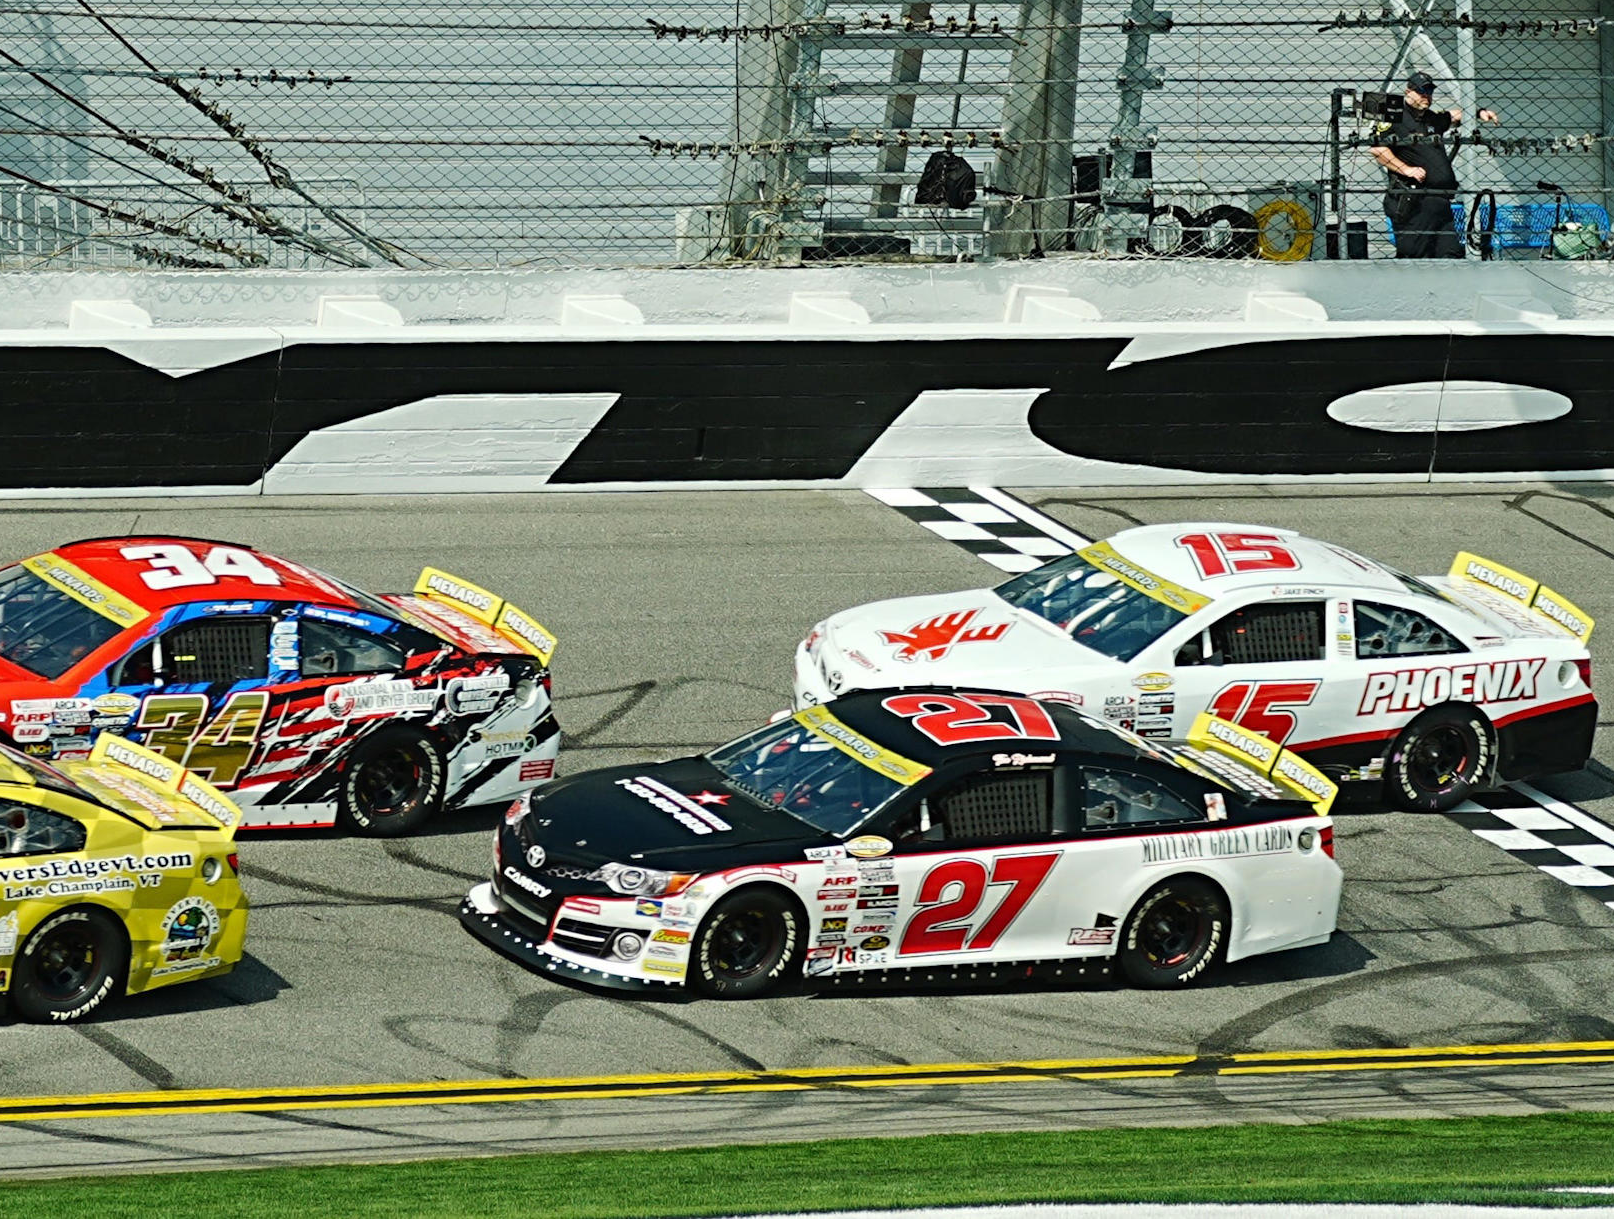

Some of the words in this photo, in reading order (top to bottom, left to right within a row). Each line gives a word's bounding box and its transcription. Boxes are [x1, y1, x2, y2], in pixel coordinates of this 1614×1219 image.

[119, 543, 284, 591] 34
[1103, 556, 1159, 591] MENARDS
[1174, 532, 1303, 581] 15
[46, 566, 106, 605] MENARDS
[427, 574, 493, 612] MENARDS
[1466, 561, 1529, 600] MENARDS
[504, 610, 553, 653] MENARDS
[1535, 593, 1587, 636] MENARDS
[54, 700, 77, 710] ARCA
[1103, 695, 1126, 706] ARCA
[1357, 657, 1547, 716] PHOENIX
[15, 713, 52, 723] ARP
[881, 692, 1062, 747] 27
[1205, 678, 1324, 750] 15
[137, 692, 271, 787] 34
[817, 720, 881, 760] MENARDS
[1206, 720, 1272, 762] MENARDS
[105, 741, 174, 783] MENARDS
[1276, 757, 1333, 800] MENARDS
[180, 778, 236, 828] MENARDS
[809, 849, 832, 860] ARCA
[1139, 835, 1204, 864] MILITARY
[1209, 832, 1250, 857] GREEN
[1255, 825, 1294, 853] CARDS
[4, 886, 44, 901] Lake
[48, 877, 136, 896] Champlain,
[139, 873, 163, 887] VT
[504, 866, 552, 898] CAMRY
[822, 876, 858, 887] ARP
[898, 852, 1062, 957] 27
[768, 910, 796, 978] GENERAL
[1178, 920, 1222, 983] GENERAL
[51, 973, 115, 1023] GENERAL
